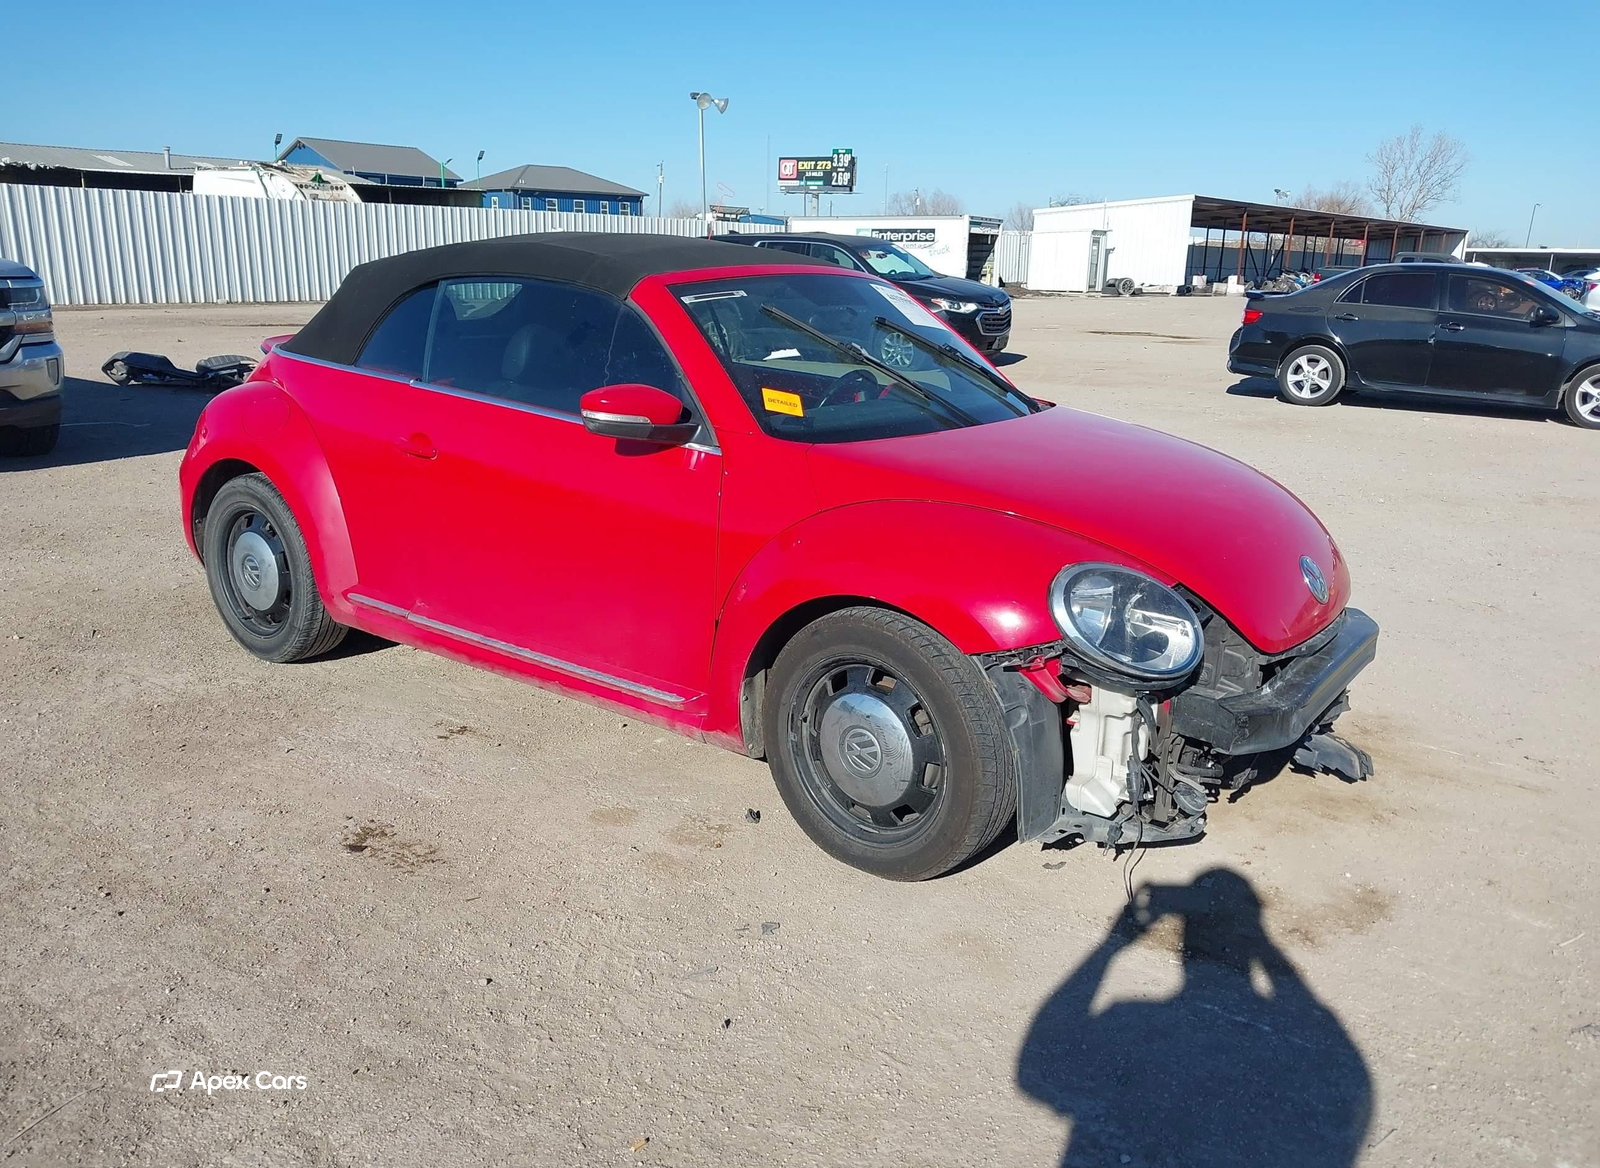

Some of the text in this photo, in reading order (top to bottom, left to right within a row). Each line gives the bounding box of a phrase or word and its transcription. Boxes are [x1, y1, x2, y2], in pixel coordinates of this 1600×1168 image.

[798, 161, 832, 170] EXIT 273
[872, 230, 935, 243] Enterprise
[767, 397, 798, 408] DETAILED
[845, 729, 882, 771] VW
